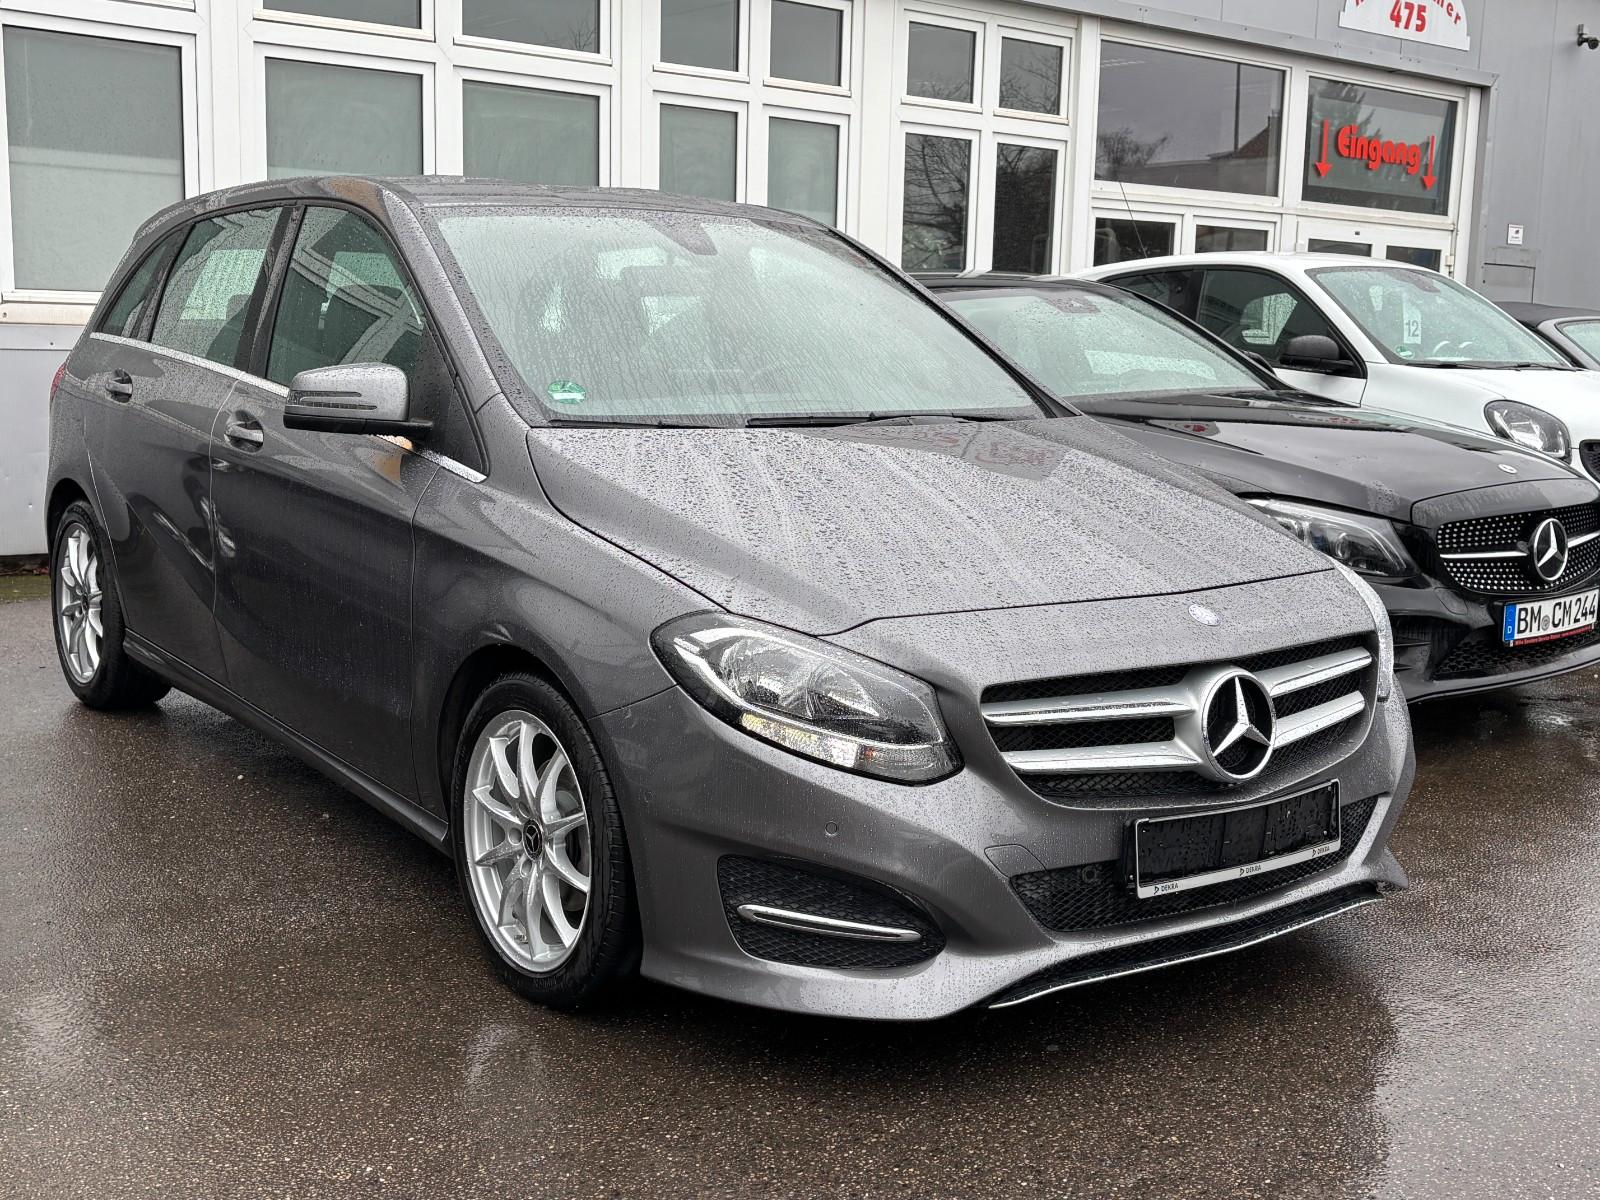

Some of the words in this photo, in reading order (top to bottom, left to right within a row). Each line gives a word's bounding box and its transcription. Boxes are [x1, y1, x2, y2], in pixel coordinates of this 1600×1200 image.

[1389, 0, 1427, 32] 475
[1337, 124, 1421, 175] Eingang
[1405, 320, 1419, 337] 12
[1516, 604, 1542, 635] BM
[1507, 625, 1513, 634] D
[1245, 864, 1261, 874] DEKRA
[1160, 882, 1179, 892] DEKRA
